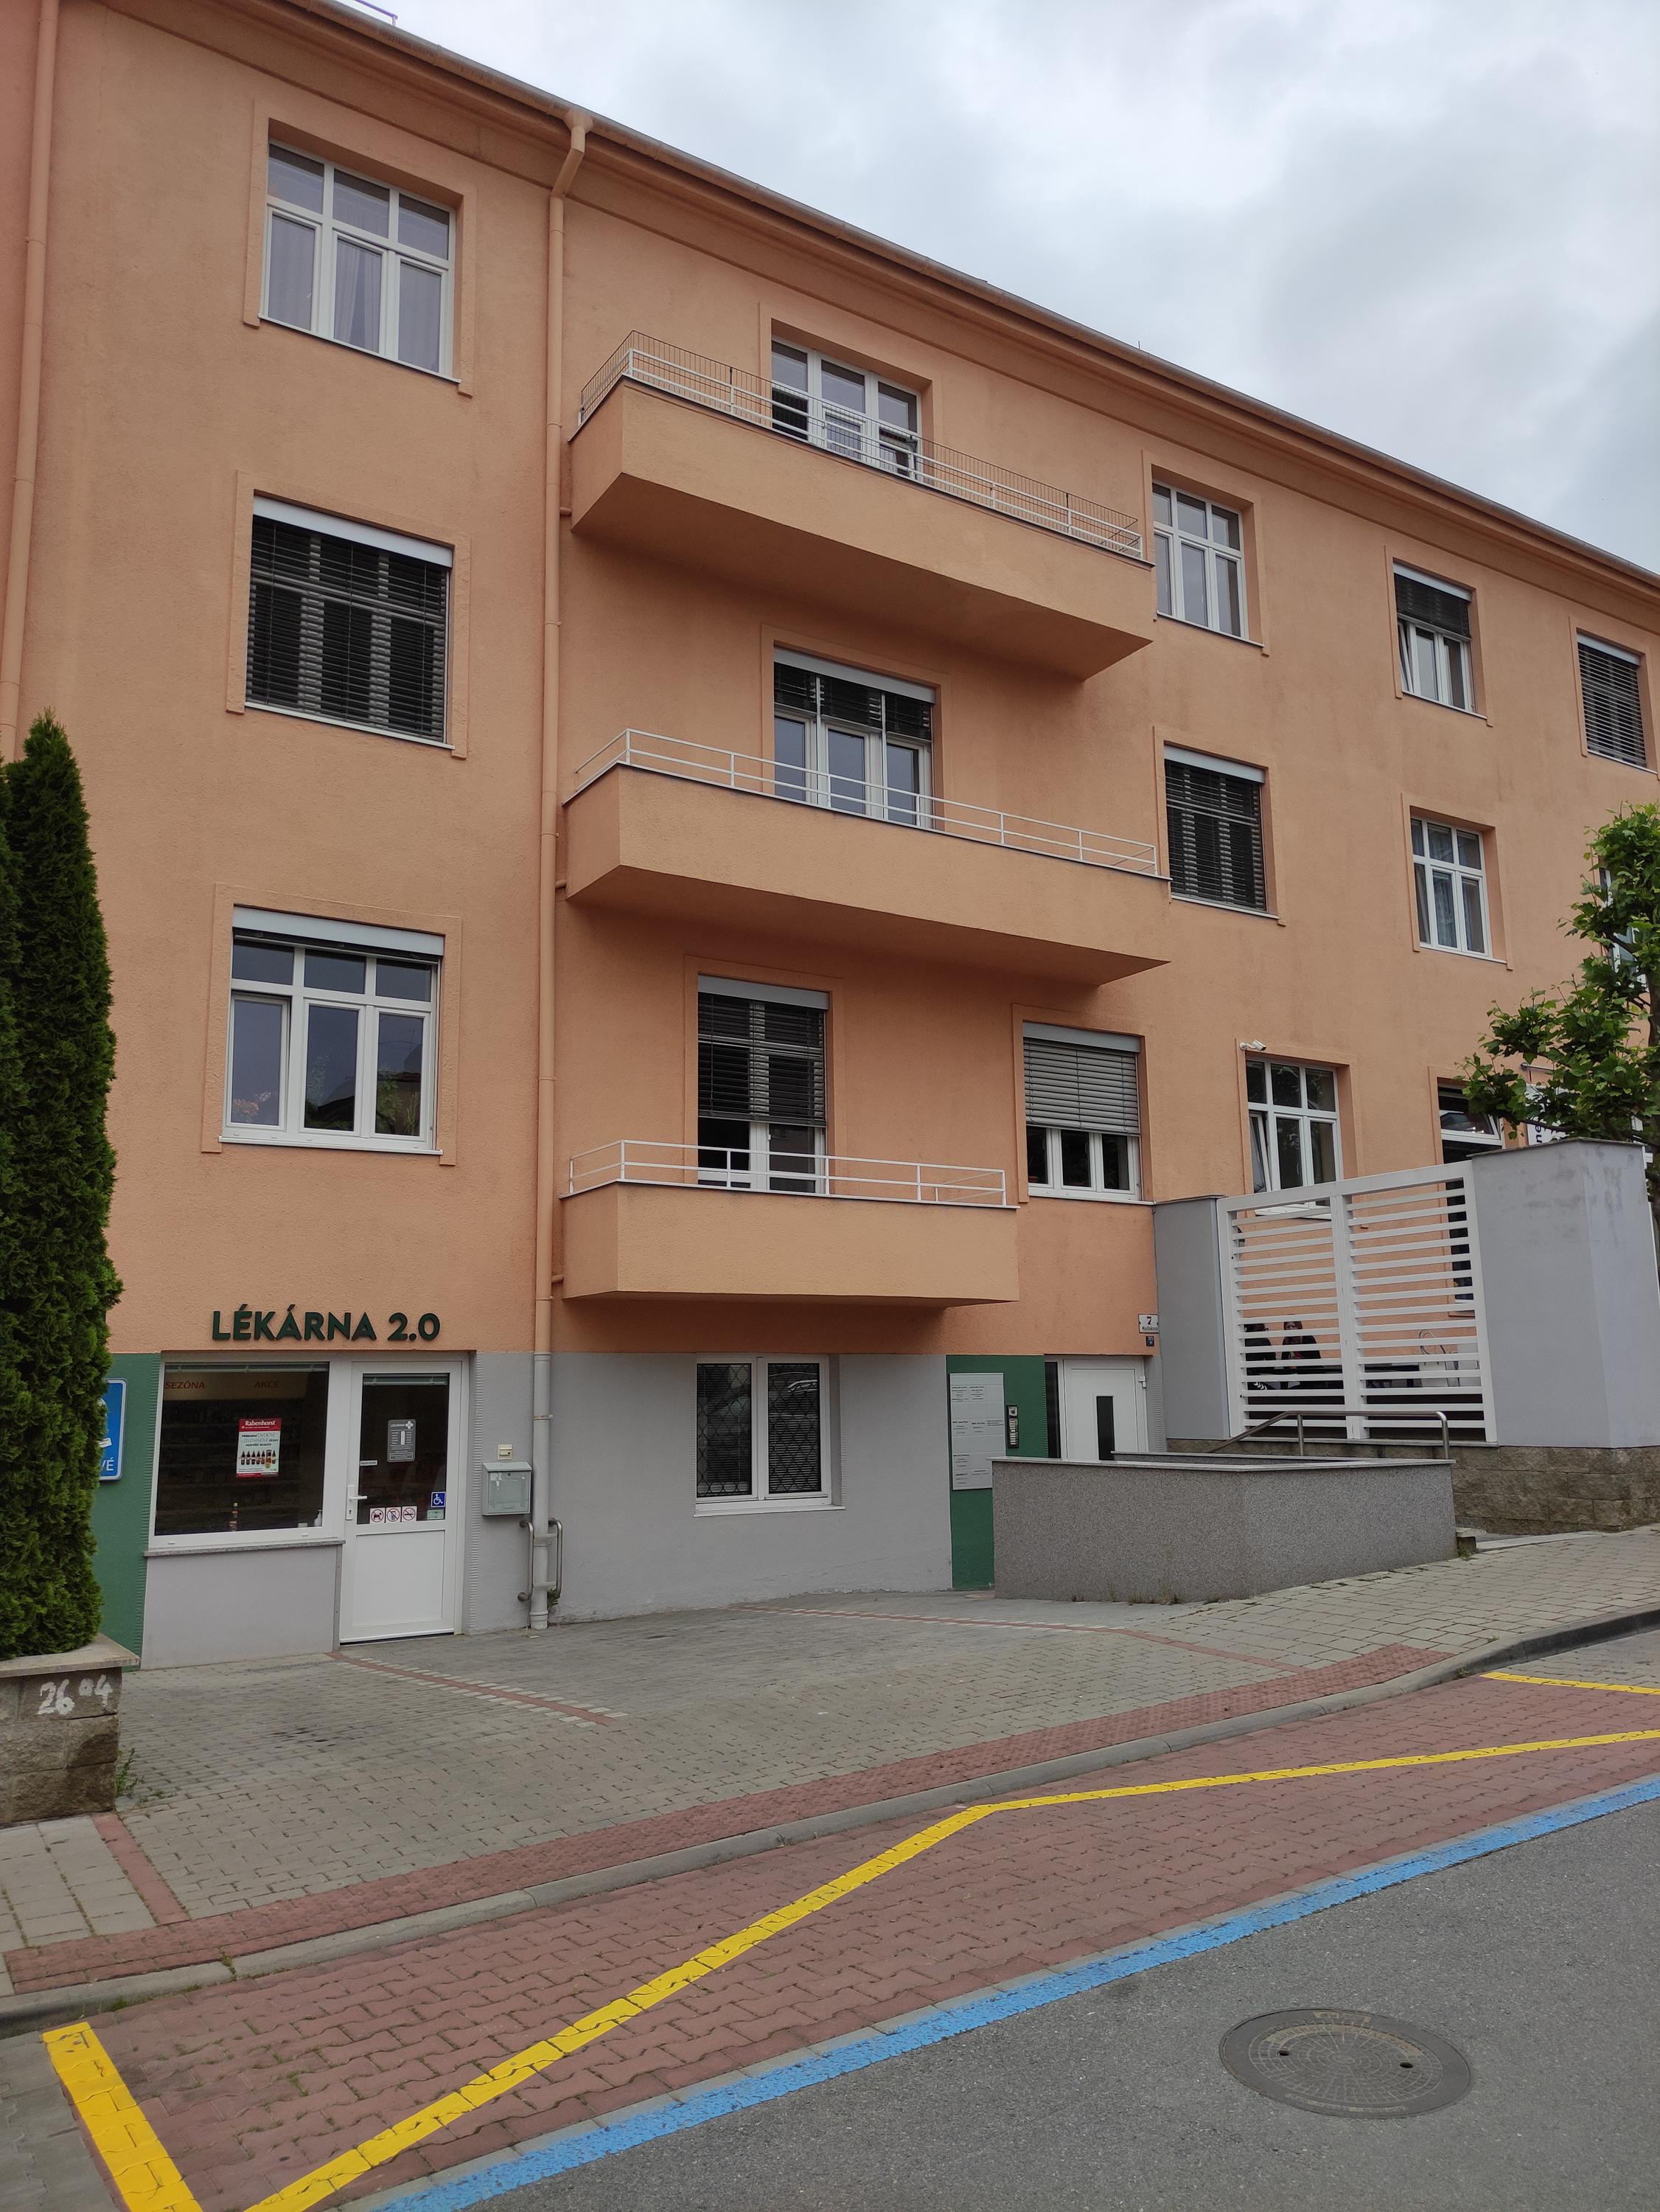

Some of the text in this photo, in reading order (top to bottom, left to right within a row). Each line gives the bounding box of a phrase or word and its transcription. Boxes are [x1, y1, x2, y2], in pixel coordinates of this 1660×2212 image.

[212, 1304, 440, 1342] LÉKÁRNA 2.0
[1146, 1316, 1152, 1325] 7
[164, 1380, 206, 1389] SEZÓNA
[254, 1380, 280, 1388] AKCE
